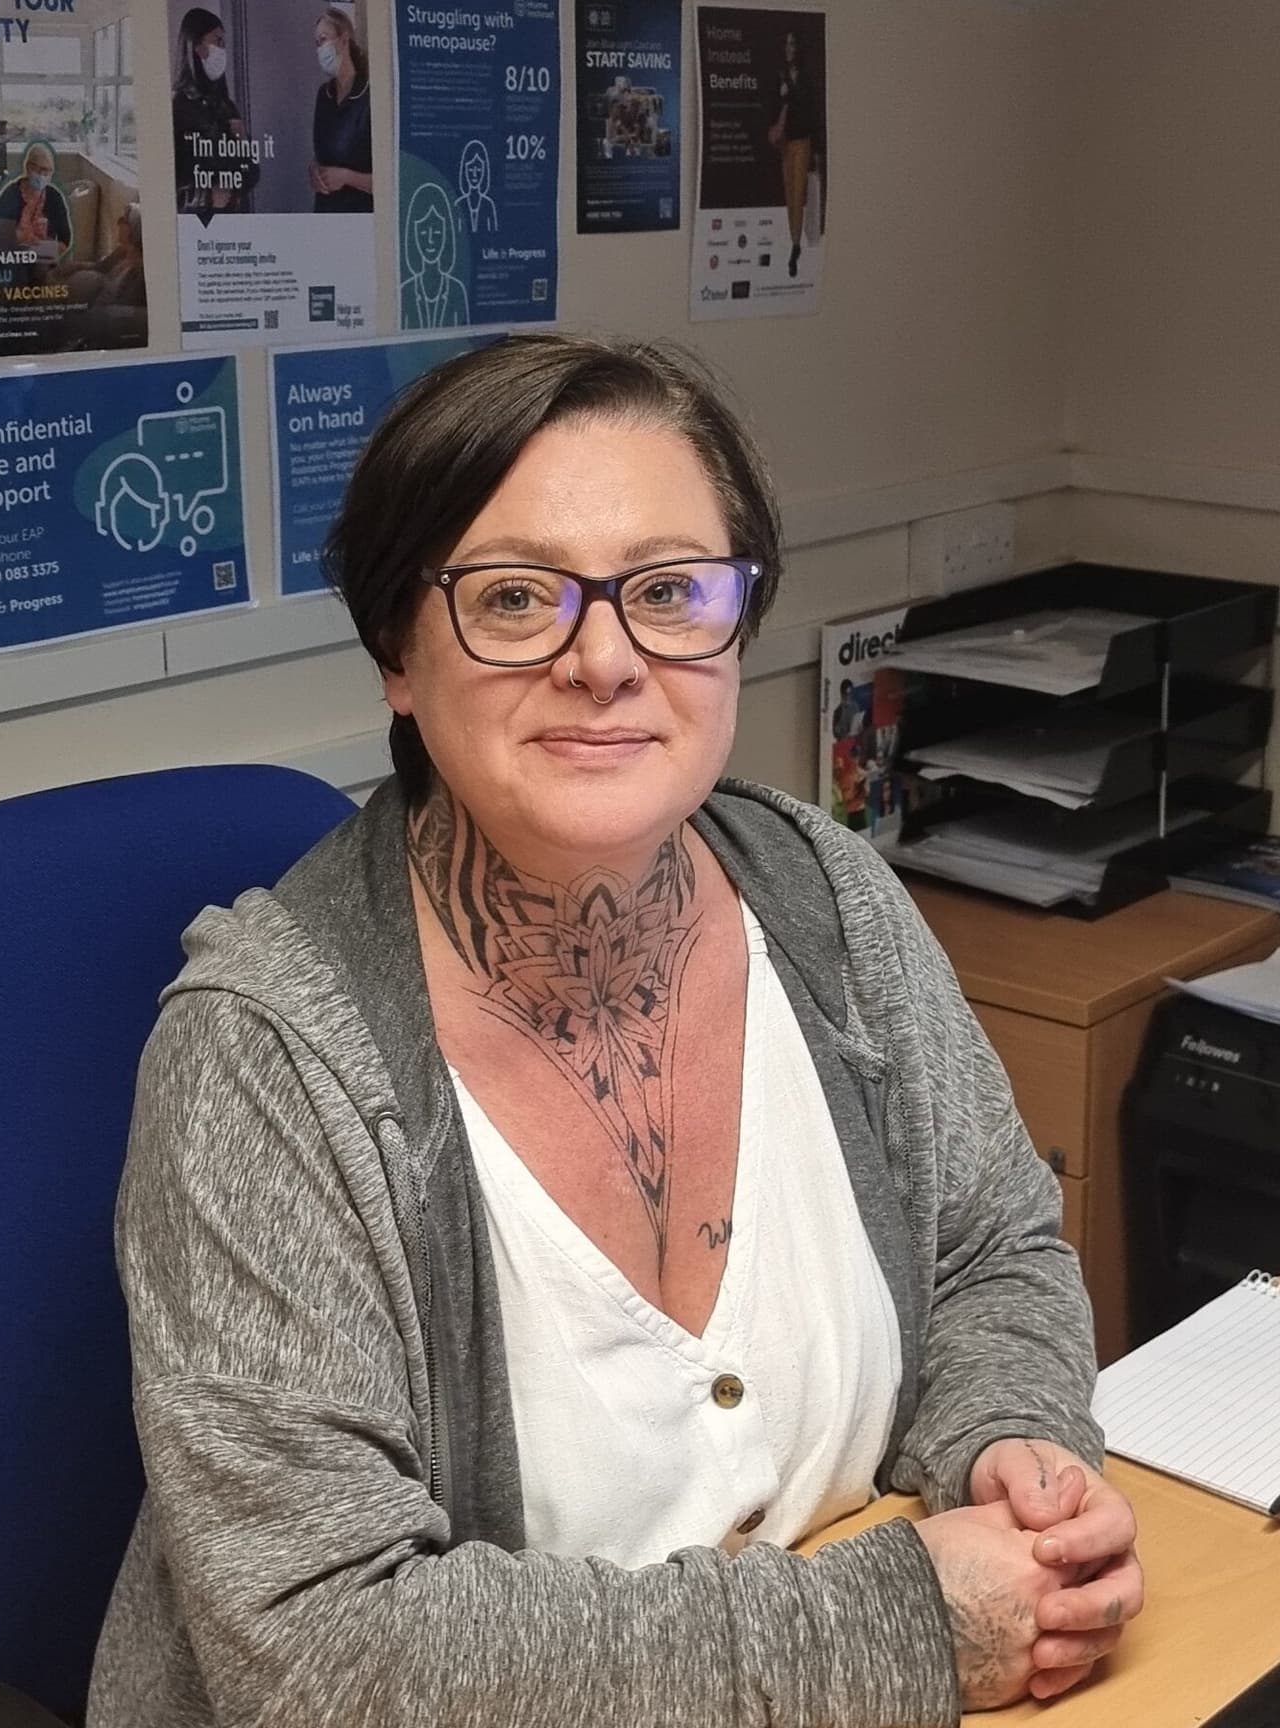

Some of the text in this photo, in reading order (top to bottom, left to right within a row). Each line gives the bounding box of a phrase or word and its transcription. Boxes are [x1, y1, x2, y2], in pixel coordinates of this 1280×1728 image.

[407, 4, 514, 31] Struggling with
[409, 34, 496, 52] menopause?
[706, 26, 742, 41] Home
[586, 50, 671, 70] START SAVING
[506, 66, 550, 92] 8/10
[710, 73, 758, 90] Benefits
[218, 132, 260, 164] doing
[264, 133, 274, 158] it
[506, 135, 546, 160] 10%
[193, 164, 214, 189] for
[197, 253, 224, 265] cervical
[226, 255, 258, 267] screening
[482, 248, 498, 260] Life
[508, 248, 546, 261] Progress
[4, 284, 69, 300] VACCINES
[288, 384, 352, 406] Always
[289, 405, 364, 432] on hand
[15, 448, 56, 473] and
[22, 526, 44, 541] EAP
[292, 552, 312, 564] Life
[4, 566, 28, 580] 083
[31, 560, 60, 578] 3375
[10, 594, 64, 612] Progress
[1181, 1035, 1240, 1064] Fellowes
